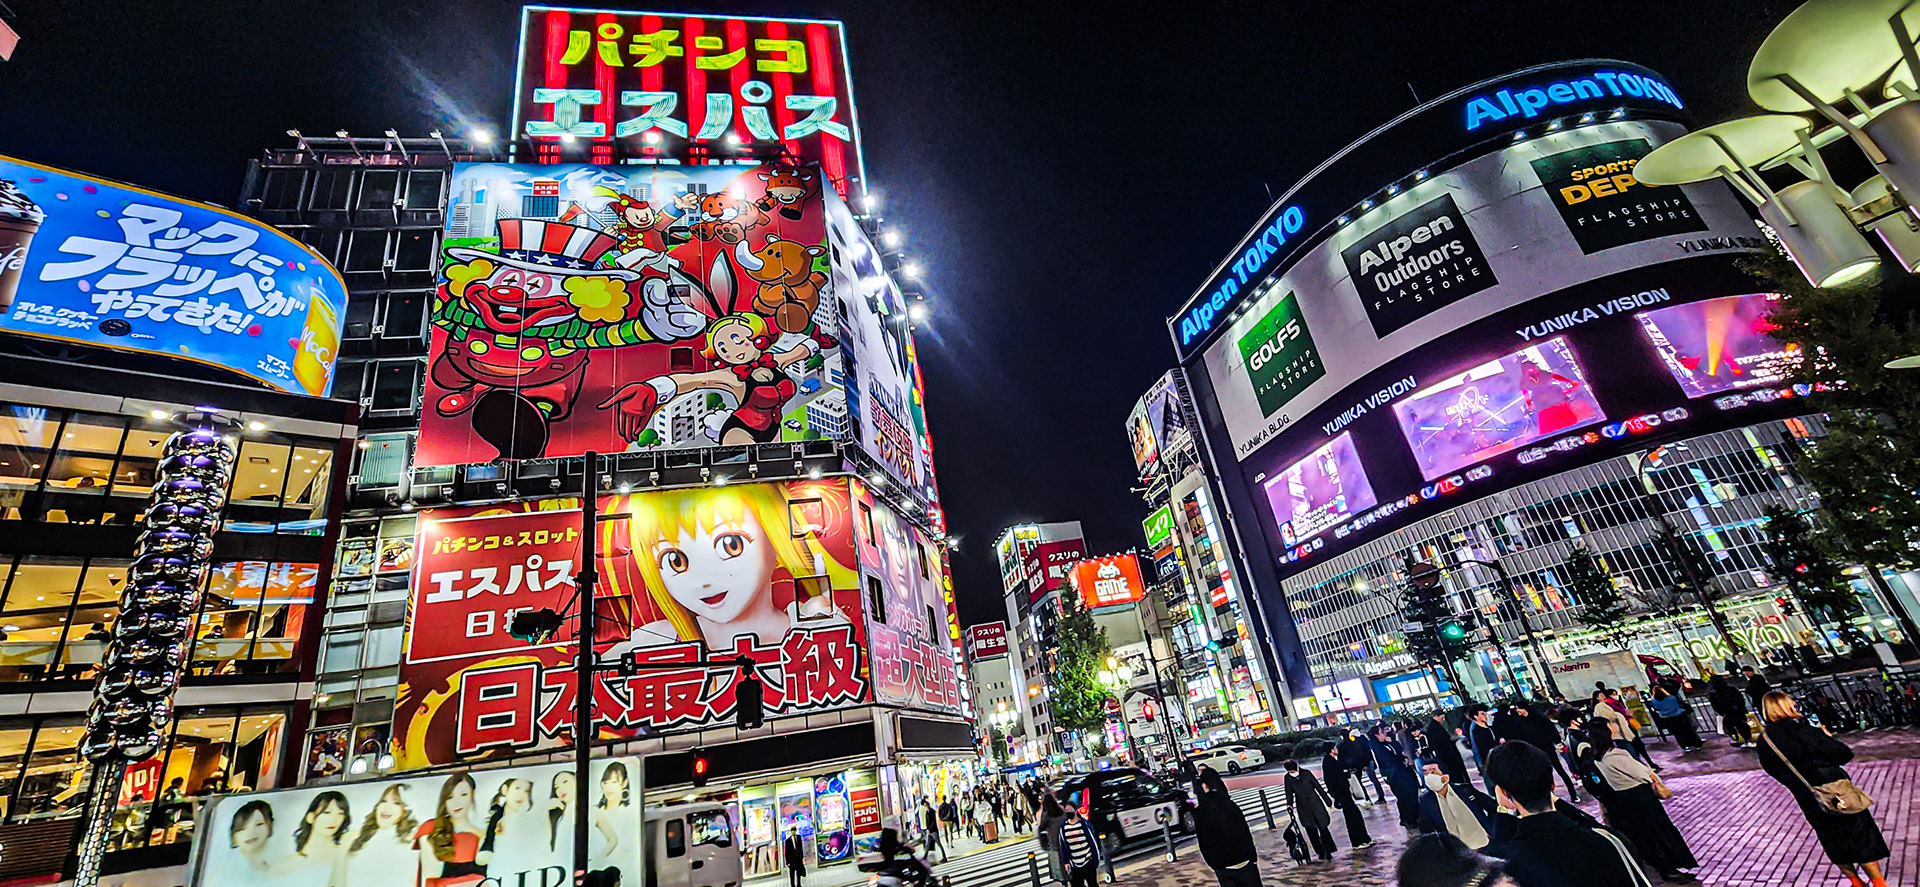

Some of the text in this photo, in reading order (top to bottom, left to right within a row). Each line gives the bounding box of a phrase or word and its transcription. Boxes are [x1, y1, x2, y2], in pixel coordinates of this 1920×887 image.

[559, 22, 808, 73] パチンコ
[525, 80, 850, 142] エスパス
[1560, 173, 1661, 206] DEP
[1578, 199, 1680, 226] FLAGSHIP
[118, 203, 283, 275] マックに
[1626, 210, 1690, 227] STORE
[1360, 214, 1454, 276] Alpen
[1374, 240, 1465, 292] Outdoors
[1676, 237, 1739, 253] YUNIKA
[39, 236, 306, 317] フラッペが
[1374, 256, 1474, 311] FLAGSHIP
[1414, 267, 1481, 302] STORE
[1515, 288, 1671, 342] YUNIKA VISION
[1249, 318, 1301, 372] GOLF5
[1259, 349, 1312, 395] FLAGSHIP
[1281, 358, 1317, 391] STORE
[1322, 404, 1367, 437] YUNIKA
[1364, 375, 1418, 410] VISION
[1238, 430, 1269, 455] YUNIKA
[1145, 511, 1168, 537] レイク
[425, 554, 577, 605] エスパス
[1048, 550, 1080, 562] クスリの
[1094, 576, 1130, 597] GAME
[977, 627, 1001, 636] クスリの
[456, 627, 867, 753] 日本最大級
[874, 625, 960, 710] 超大型店
